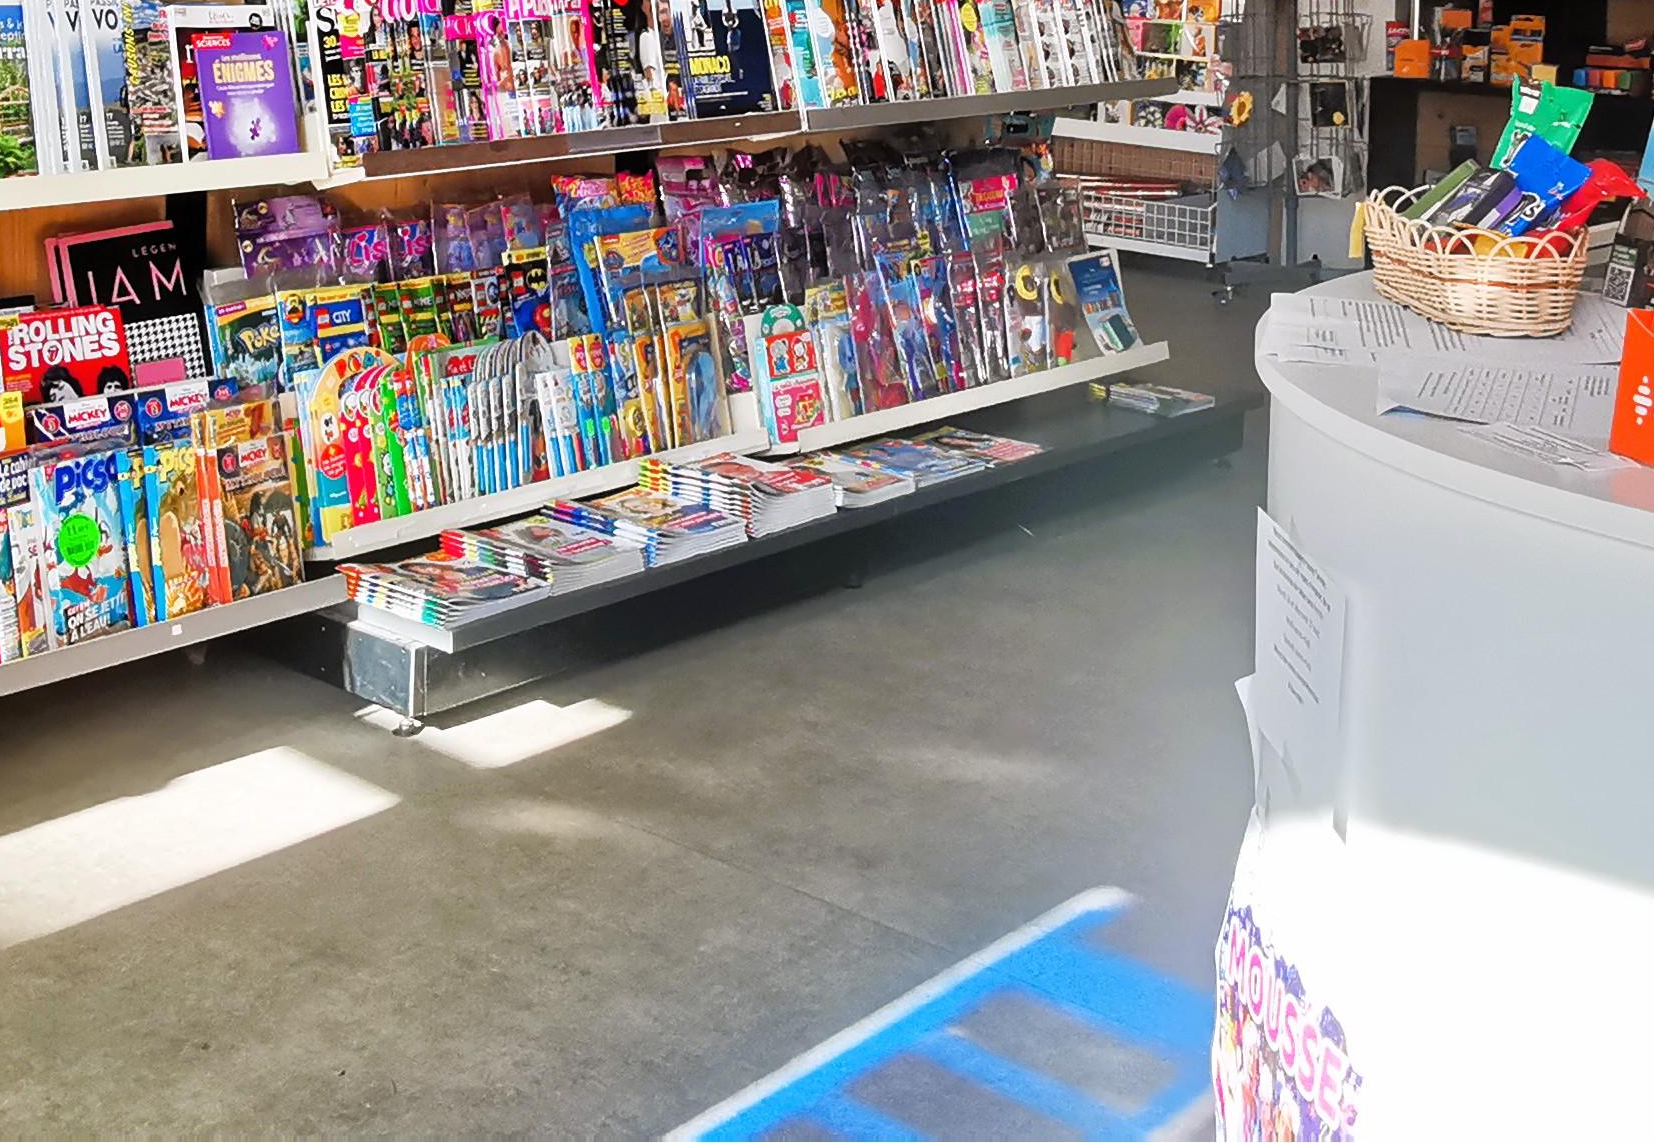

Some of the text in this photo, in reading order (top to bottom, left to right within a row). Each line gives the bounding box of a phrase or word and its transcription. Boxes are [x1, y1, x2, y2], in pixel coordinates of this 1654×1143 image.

[213, 59, 275, 84] ÉNIGMES
[688, 54, 732, 76] MONACO
[11, 311, 117, 343] ROLLING
[7, 333, 121, 371] STONES
[169, 393, 208, 411] MICKEY
[67, 405, 110, 424] MICKEY
